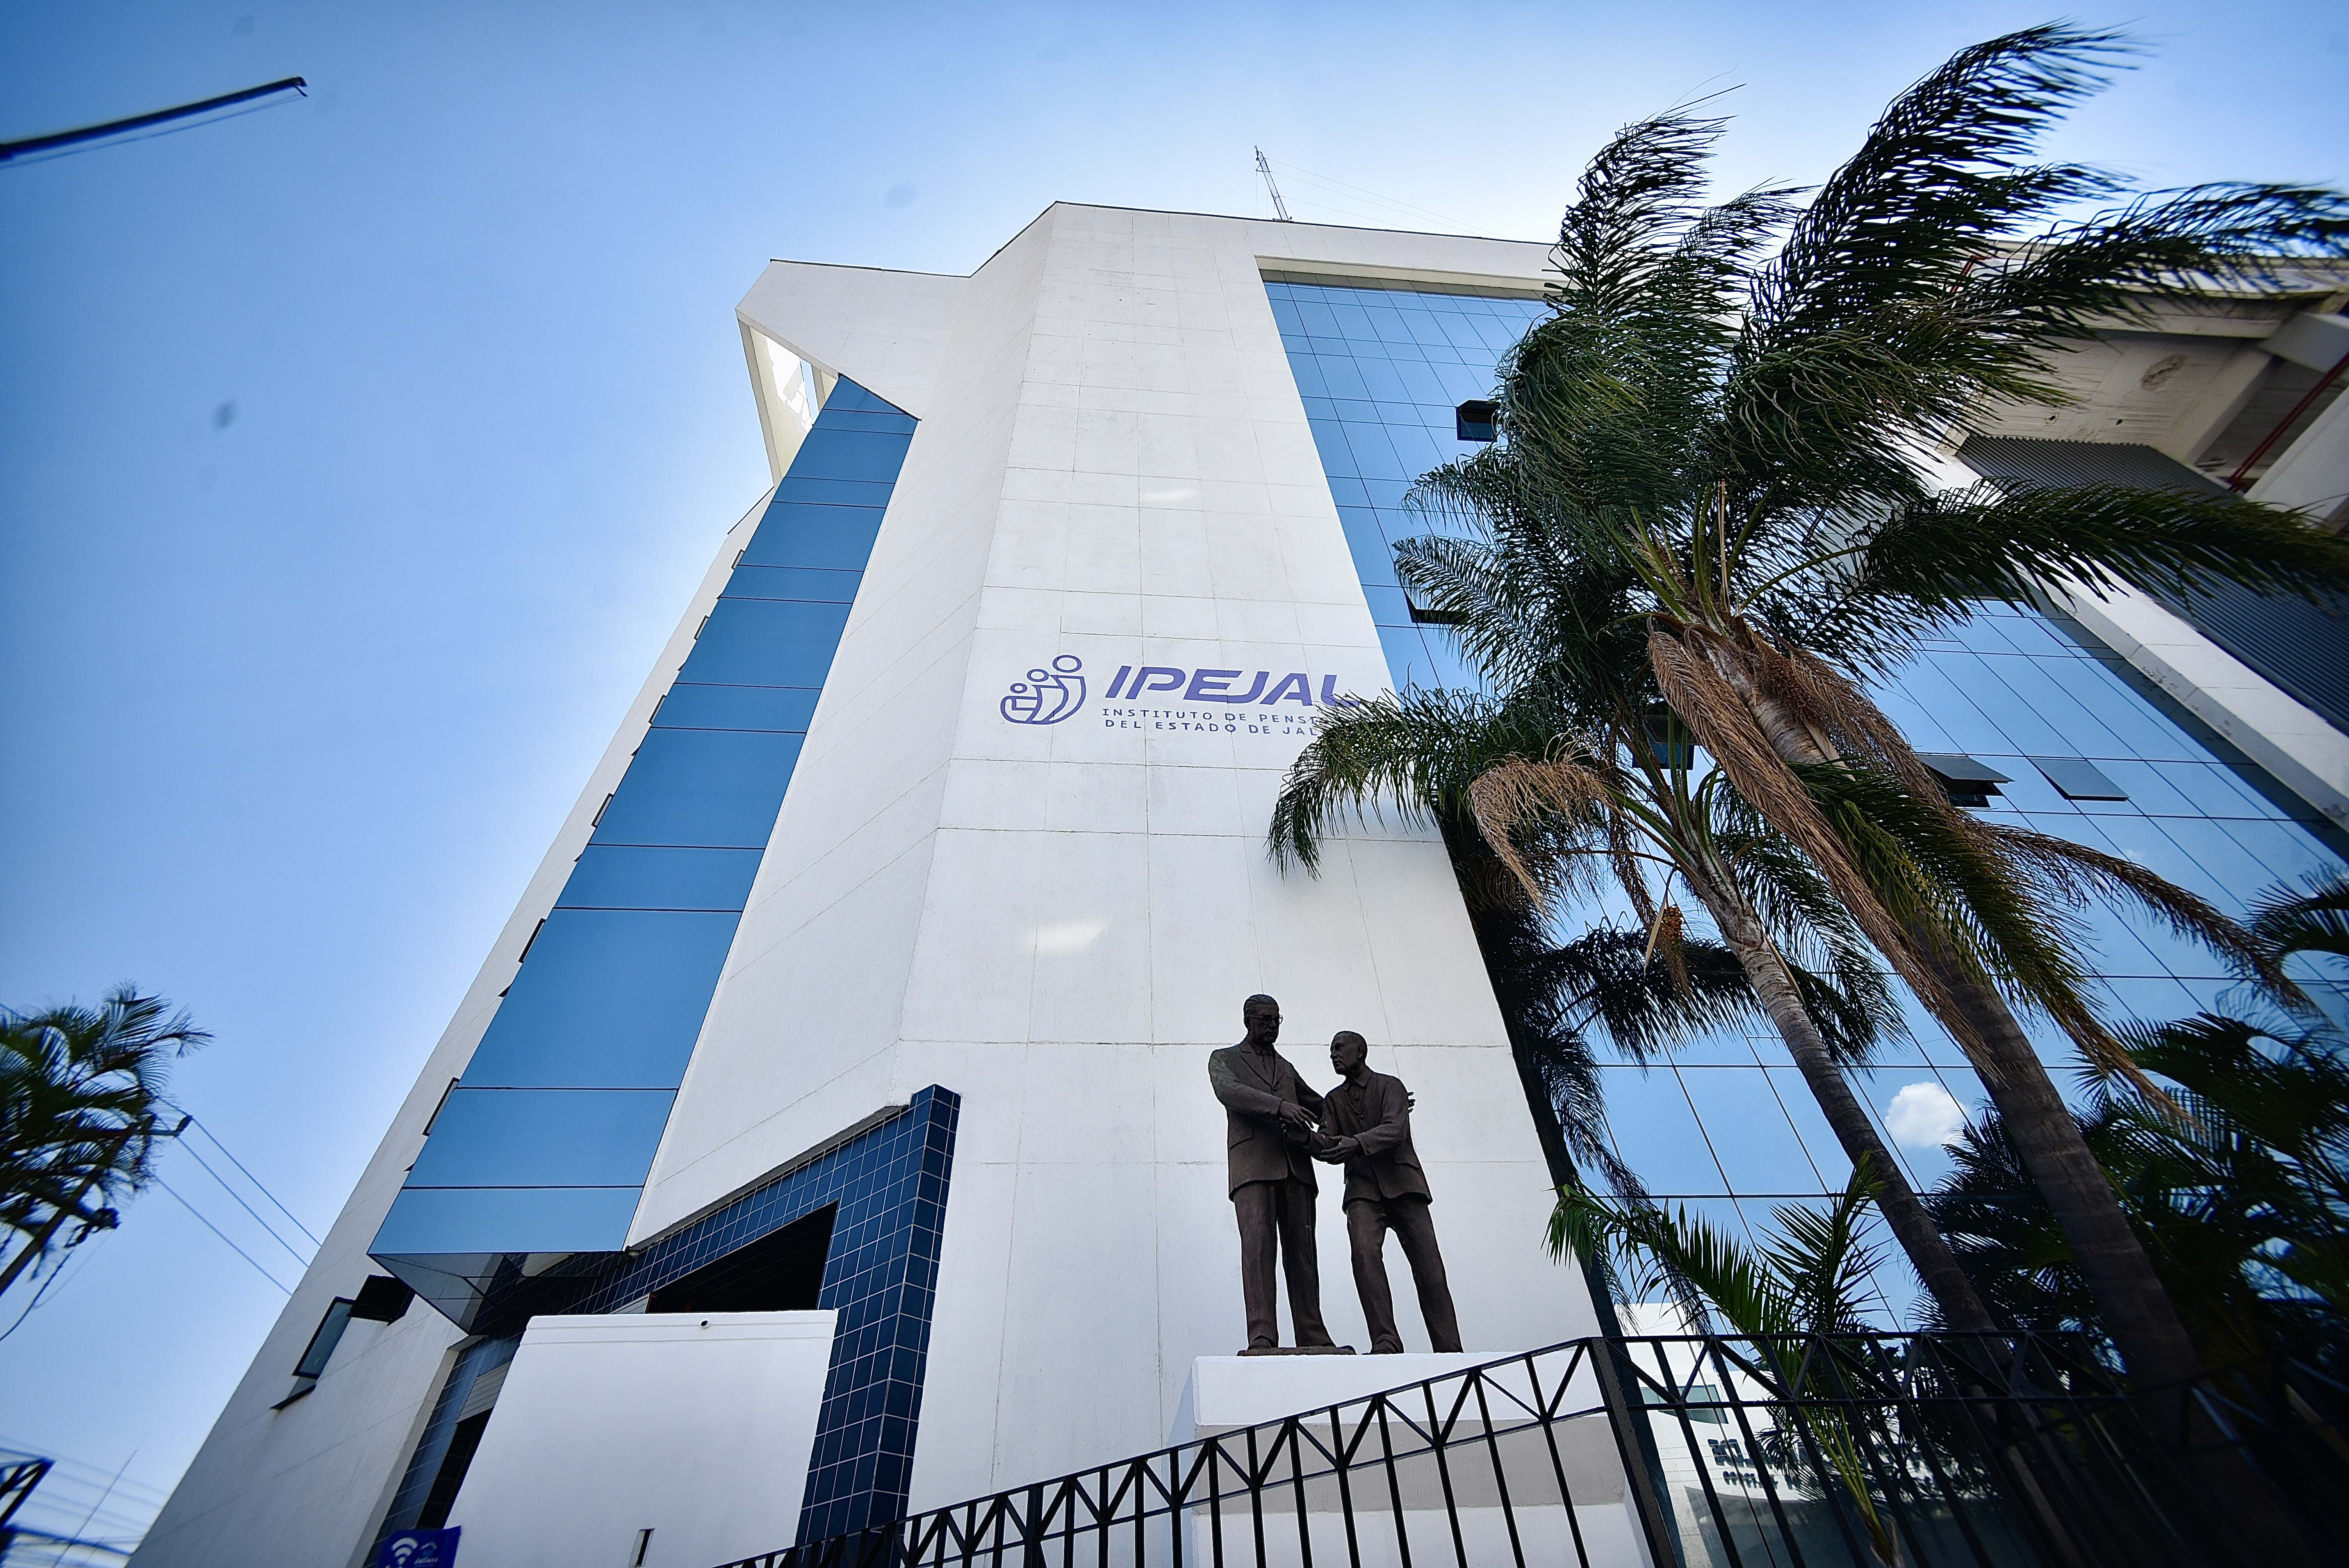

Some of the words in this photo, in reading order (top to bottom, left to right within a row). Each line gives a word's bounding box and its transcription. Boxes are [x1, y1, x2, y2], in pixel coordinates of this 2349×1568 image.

[1105, 665, 1360, 708] IPEJAL
[1102, 708, 1212, 720] INSTITUTO
[1105, 719, 1142, 729] DEL
[1155, 722, 1237, 733] ESTADO
[1248, 724, 1271, 734] DE
